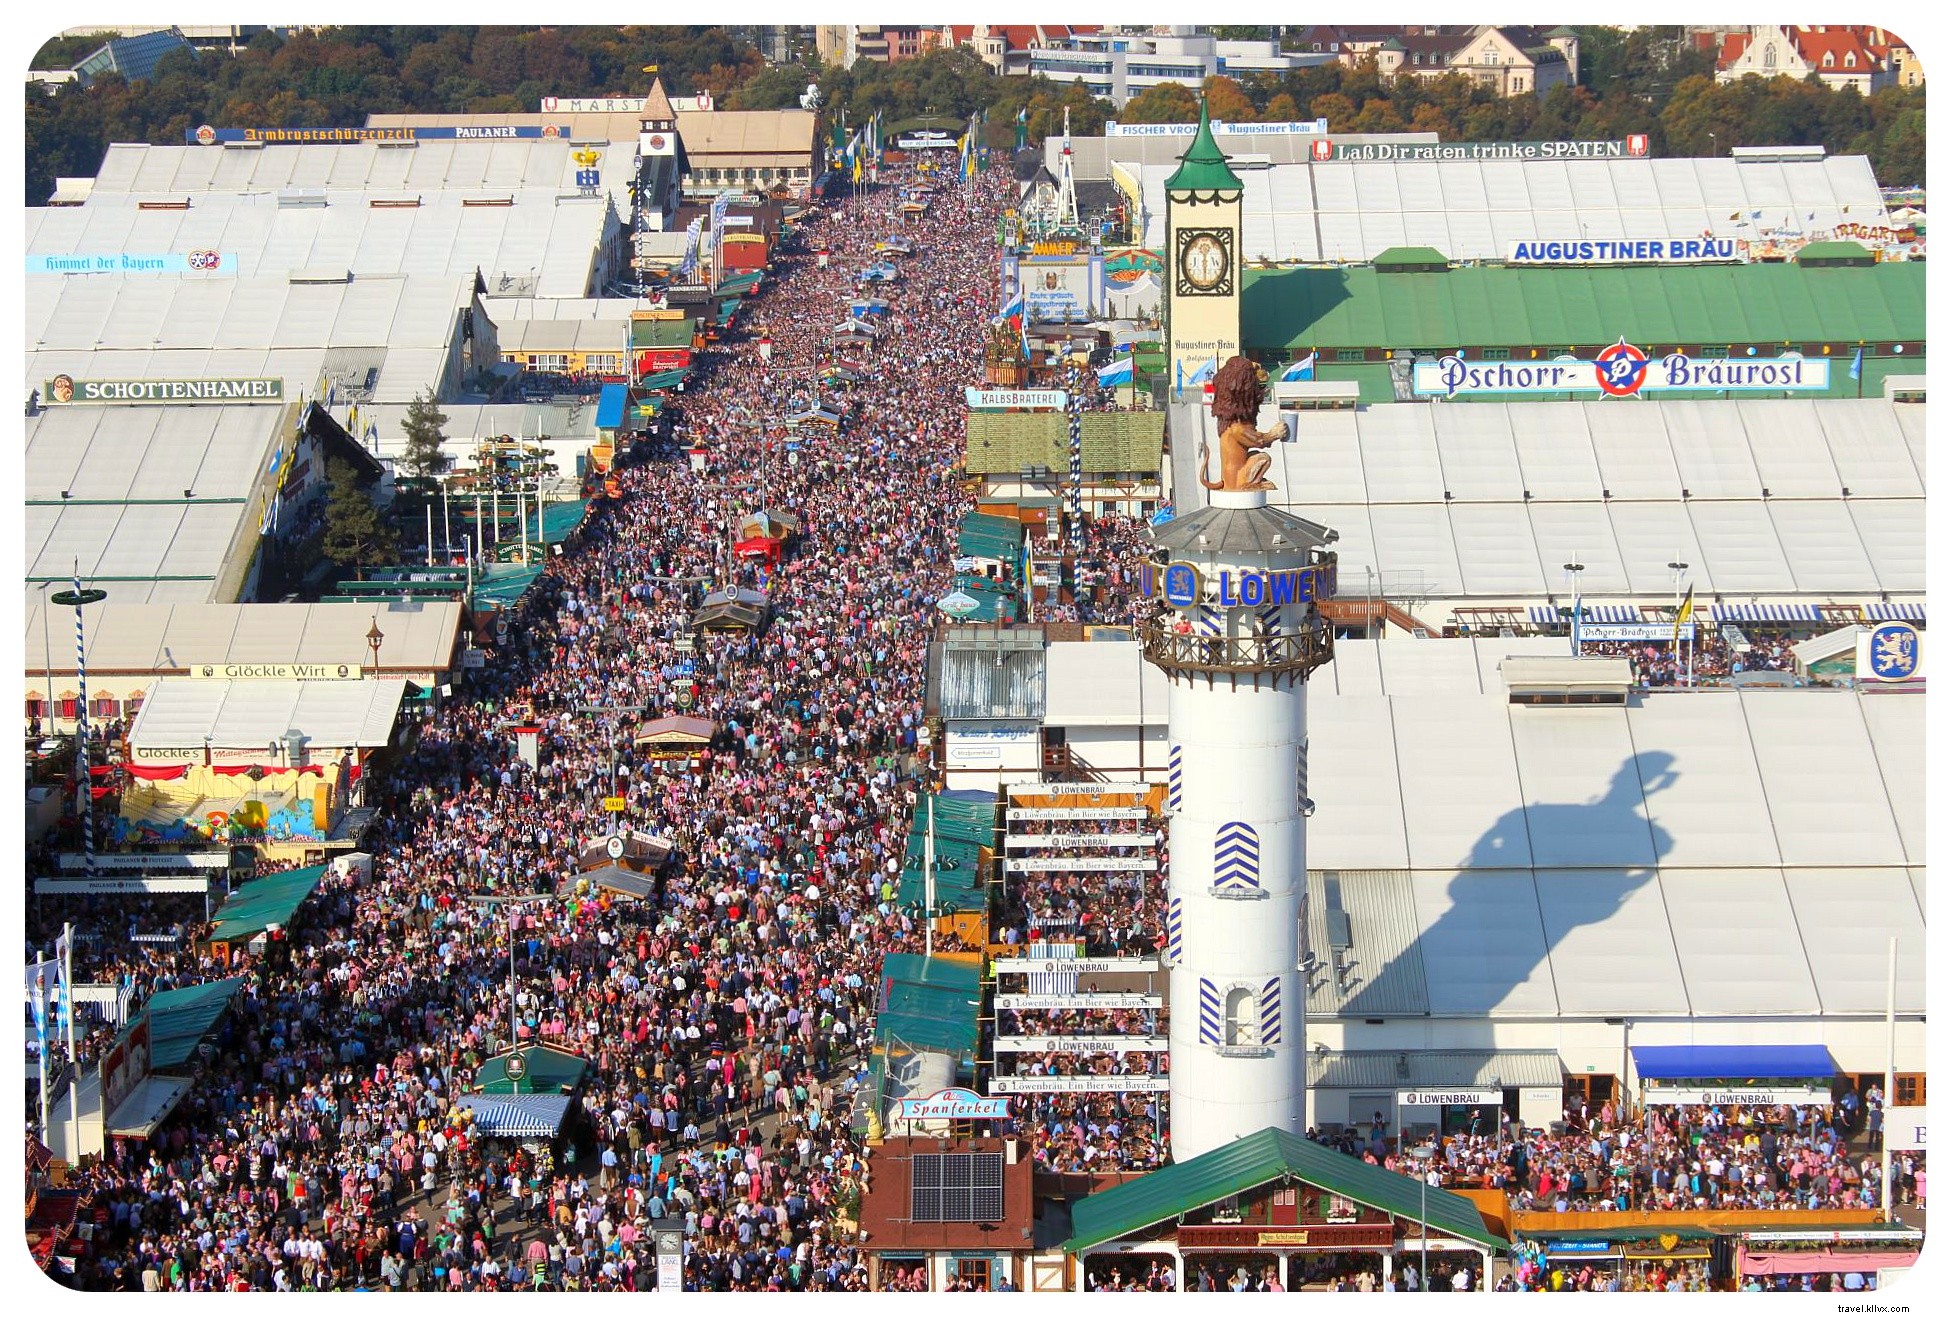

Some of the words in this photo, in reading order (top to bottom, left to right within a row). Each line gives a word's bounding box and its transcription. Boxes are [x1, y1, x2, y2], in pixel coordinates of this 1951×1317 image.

[571, 99, 684, 111] MARSTL
[455, 126, 517, 138] PAULANER
[1122, 125, 1166, 135] FISCHER
[1169, 124, 1200, 134] VRON
[1228, 123, 1287, 136] Augustiner
[1288, 121, 1311, 133] Bräu
[1338, 144, 1374, 160] Laß
[1377, 144, 1410, 159] Dir
[1473, 143, 1536, 159] trinke
[1540, 141, 1622, 157] SPATEN
[1033, 242, 1074, 256] AMMER
[1514, 241, 1664, 261] AUGUSTINER
[1668, 237, 1734, 258] BRÄU
[46, 257, 91, 270] Himmel
[97, 257, 115, 269] der
[121, 256, 165, 271] Bayern
[1440, 356, 1577, 396] Pschorr-
[1664, 353, 1802, 387] Bräurosl
[85, 381, 278, 399] SCHOTTENHAMEL
[225, 664, 287, 678] Glöckle
[292, 665, 326, 677] Wirt
[1061, 785, 1106, 794] LÖWENBRÄU
[1062, 837, 1109, 846] LÖWENBRÄU
[1056, 963, 1109, 972] LÖWENBRÄU
[1085, 998, 1102, 1006] Bier
[1105, 998, 1119, 1006] wie
[1058, 1041, 1115, 1051] LÖWENBRÄU
[1068, 1081, 1084, 1090] Ein
[1087, 1081, 1104, 1090] Bier
[1108, 1081, 1122, 1089] wie
[1419, 1092, 1480, 1104] LÖWENBRÄU
[1714, 1093, 1774, 1104] LÖWENBRÄU
[912, 1102, 998, 1117] Spanferkel
